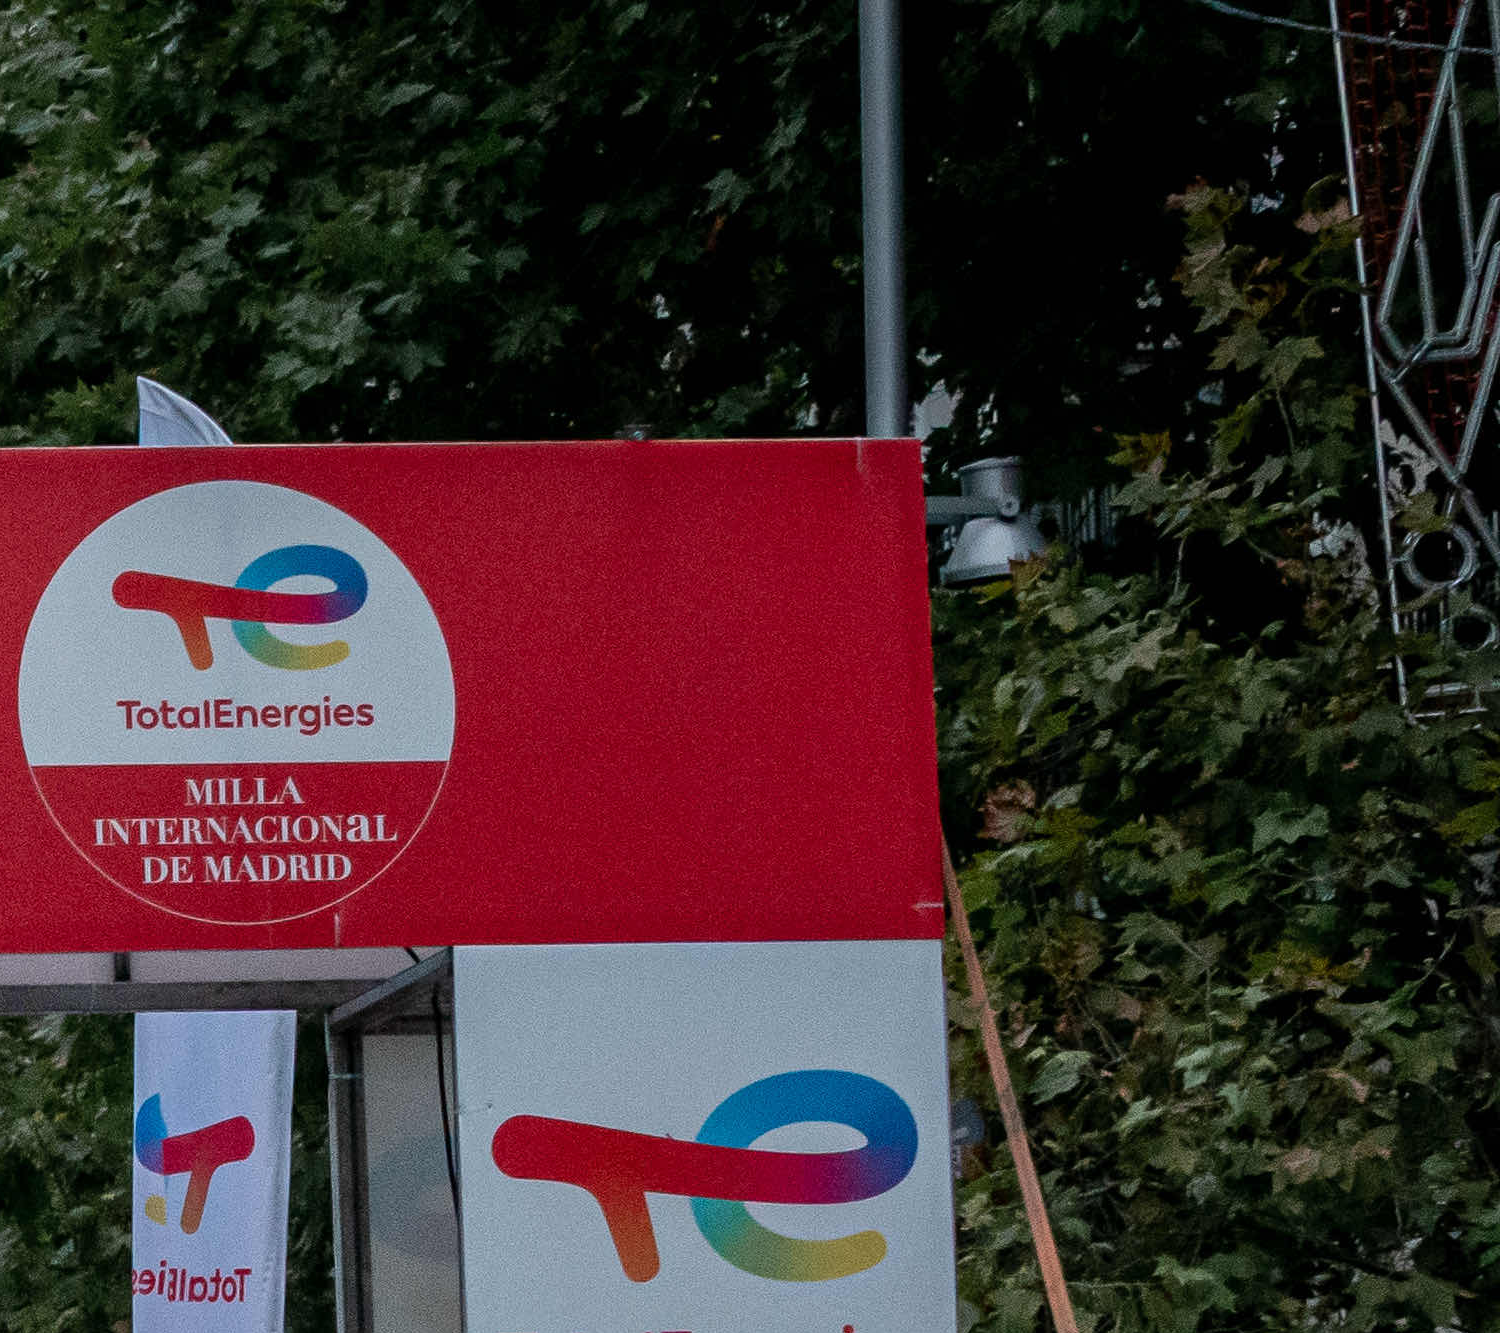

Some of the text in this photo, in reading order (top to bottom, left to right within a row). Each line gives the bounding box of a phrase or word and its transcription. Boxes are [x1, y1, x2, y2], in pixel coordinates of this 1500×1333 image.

[116, 698, 375, 737] TotalEnergies
[185, 776, 304, 807] MILLA
[143, 852, 353, 885] DE MADRID
